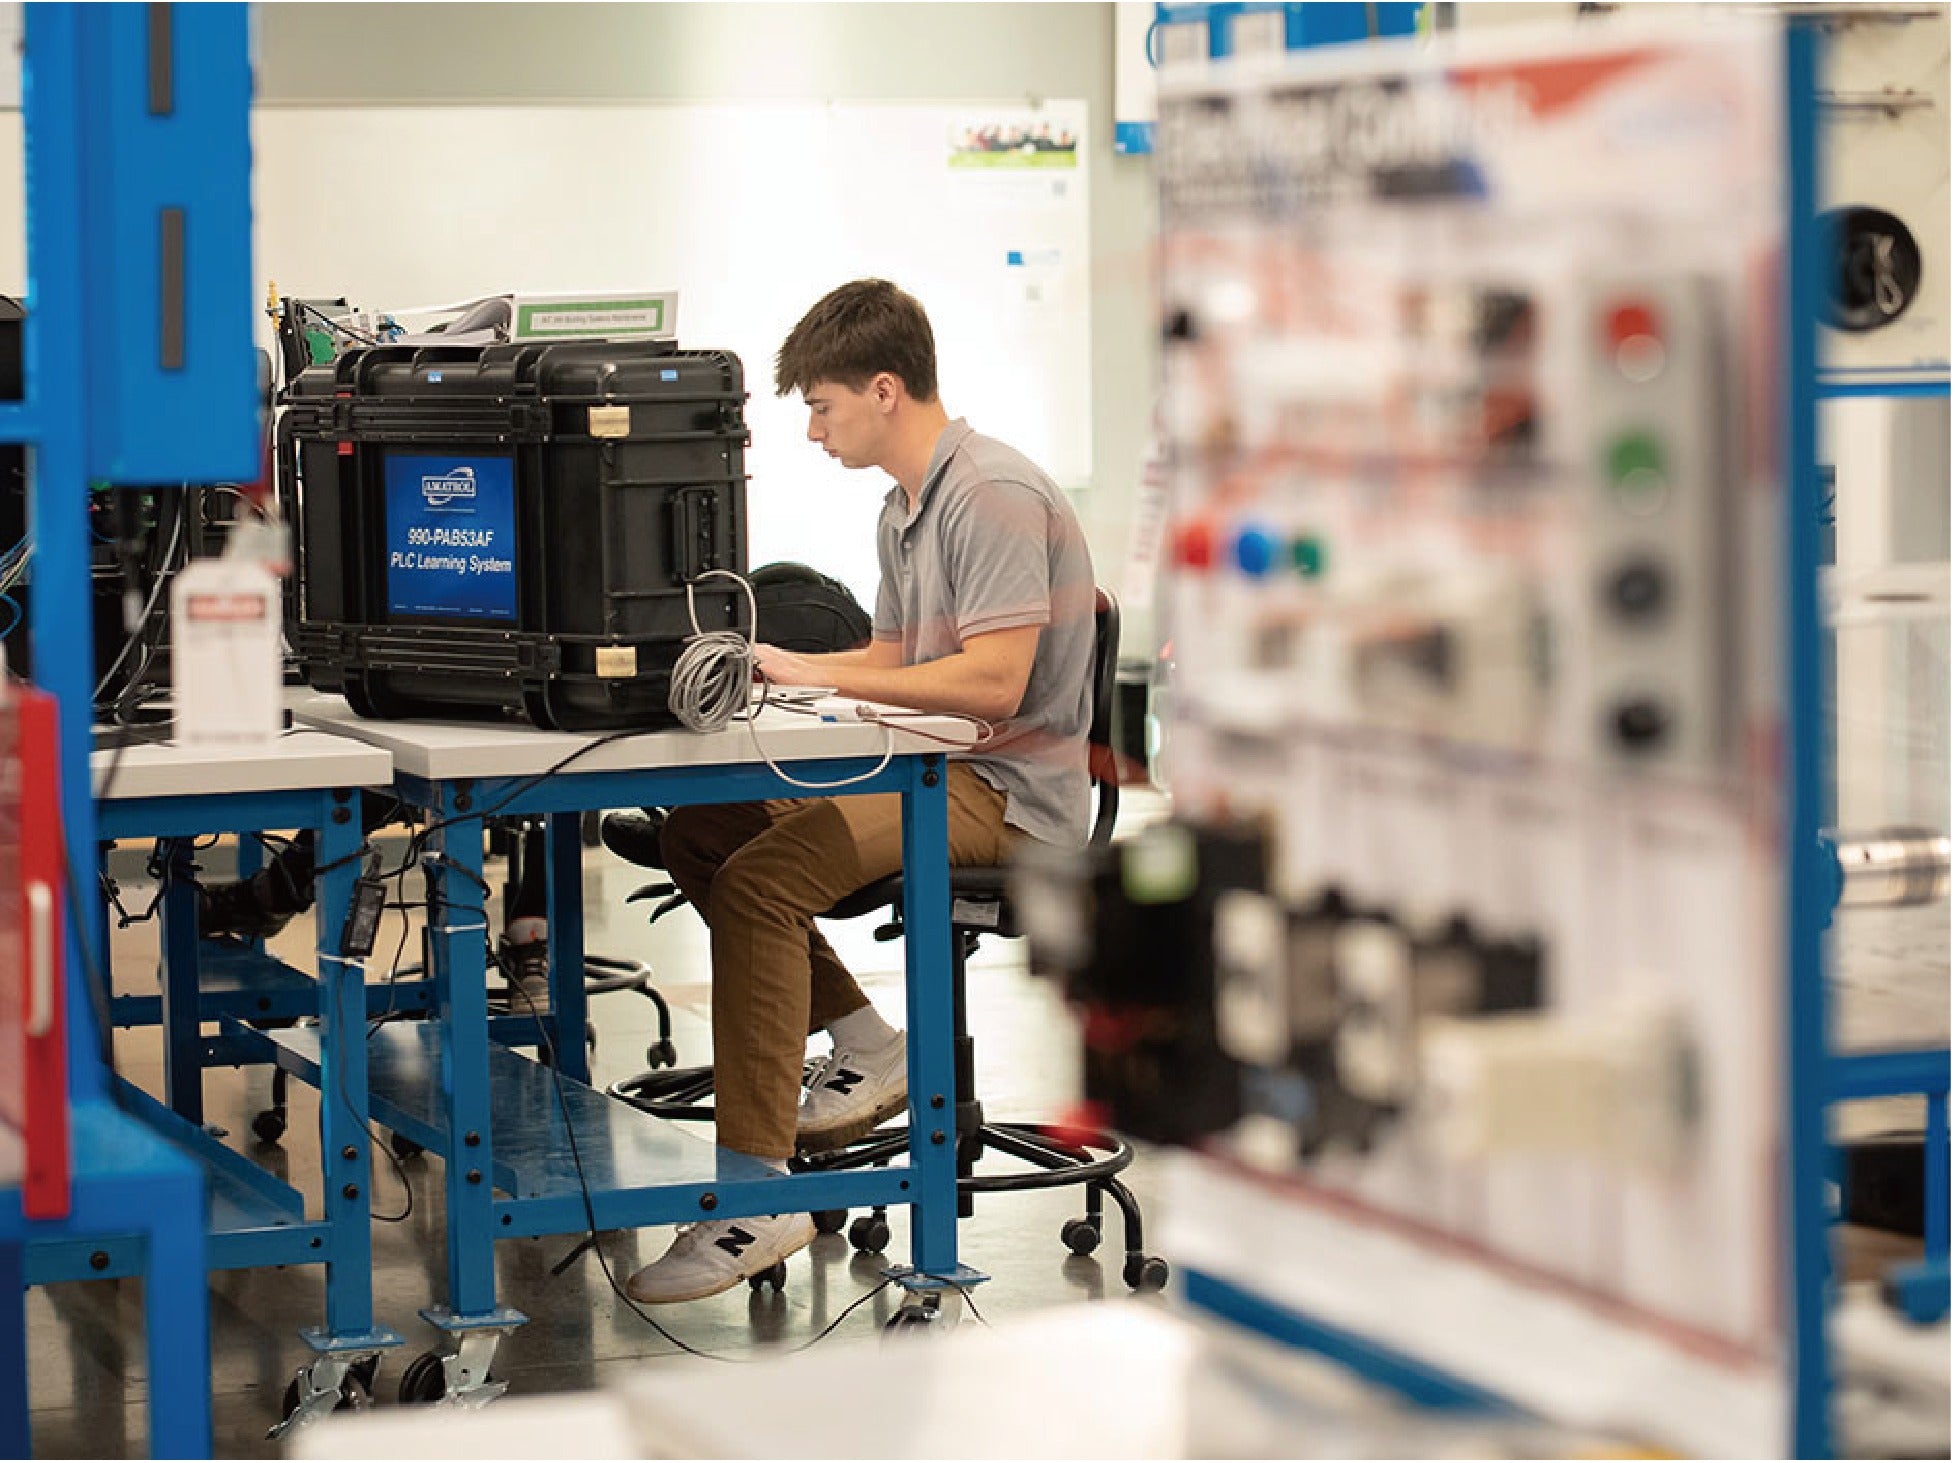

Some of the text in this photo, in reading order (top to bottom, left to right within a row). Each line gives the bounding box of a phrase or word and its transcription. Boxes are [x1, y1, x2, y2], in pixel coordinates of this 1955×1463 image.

[408, 527, 494, 546] 990-PAB53AF
[390, 552, 512, 575] PLC Learning System
[824, 1068, 865, 1095] N
[714, 1226, 757, 1257] N
